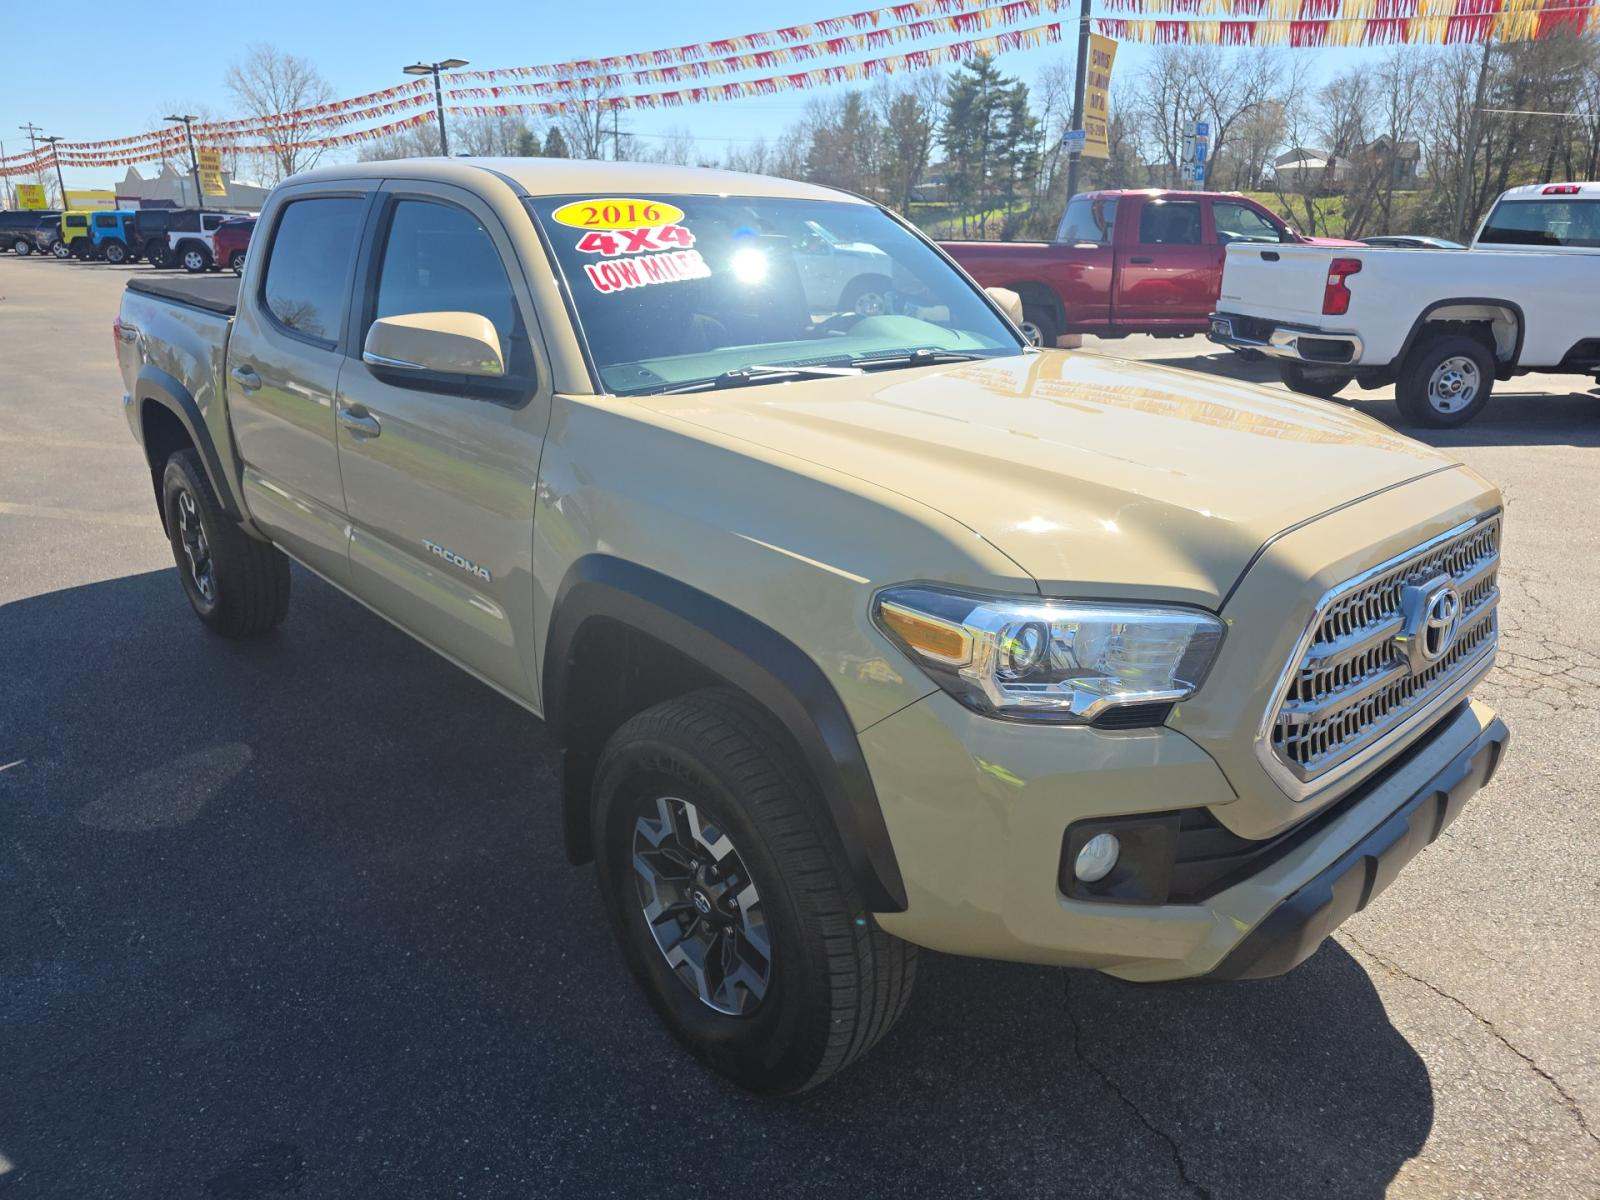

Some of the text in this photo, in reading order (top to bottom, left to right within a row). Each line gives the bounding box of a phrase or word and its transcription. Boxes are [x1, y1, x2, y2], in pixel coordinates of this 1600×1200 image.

[581, 205, 660, 225] 2016
[579, 225, 693, 254] 4X4
[588, 262, 641, 291] LOW
[421, 538, 491, 583] TACOMA
